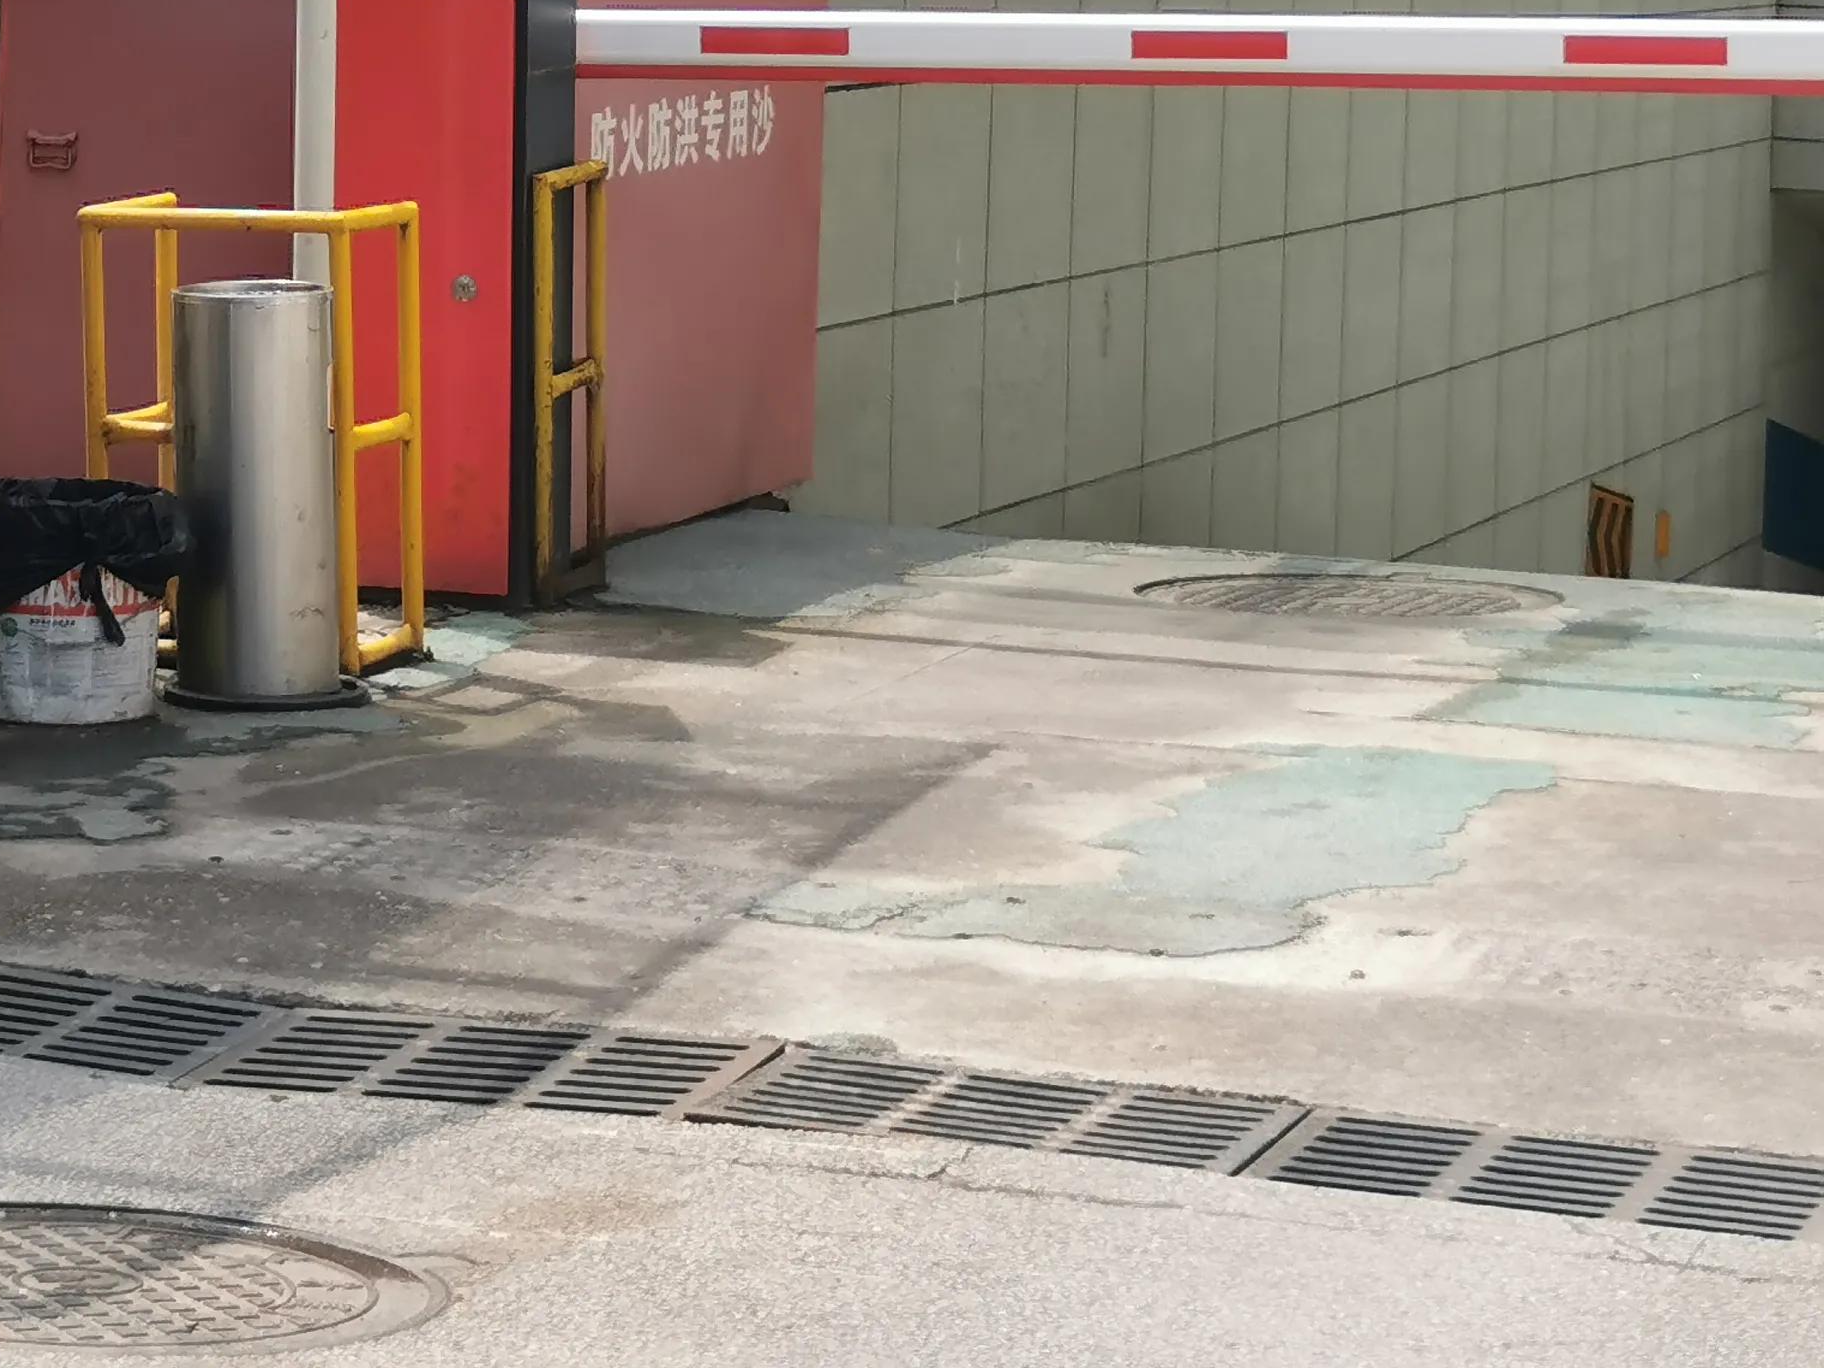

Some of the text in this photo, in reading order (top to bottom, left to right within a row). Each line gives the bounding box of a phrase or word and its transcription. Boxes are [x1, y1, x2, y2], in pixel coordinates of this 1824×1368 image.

[590, 84, 775, 180] 防火防洪专用沙
